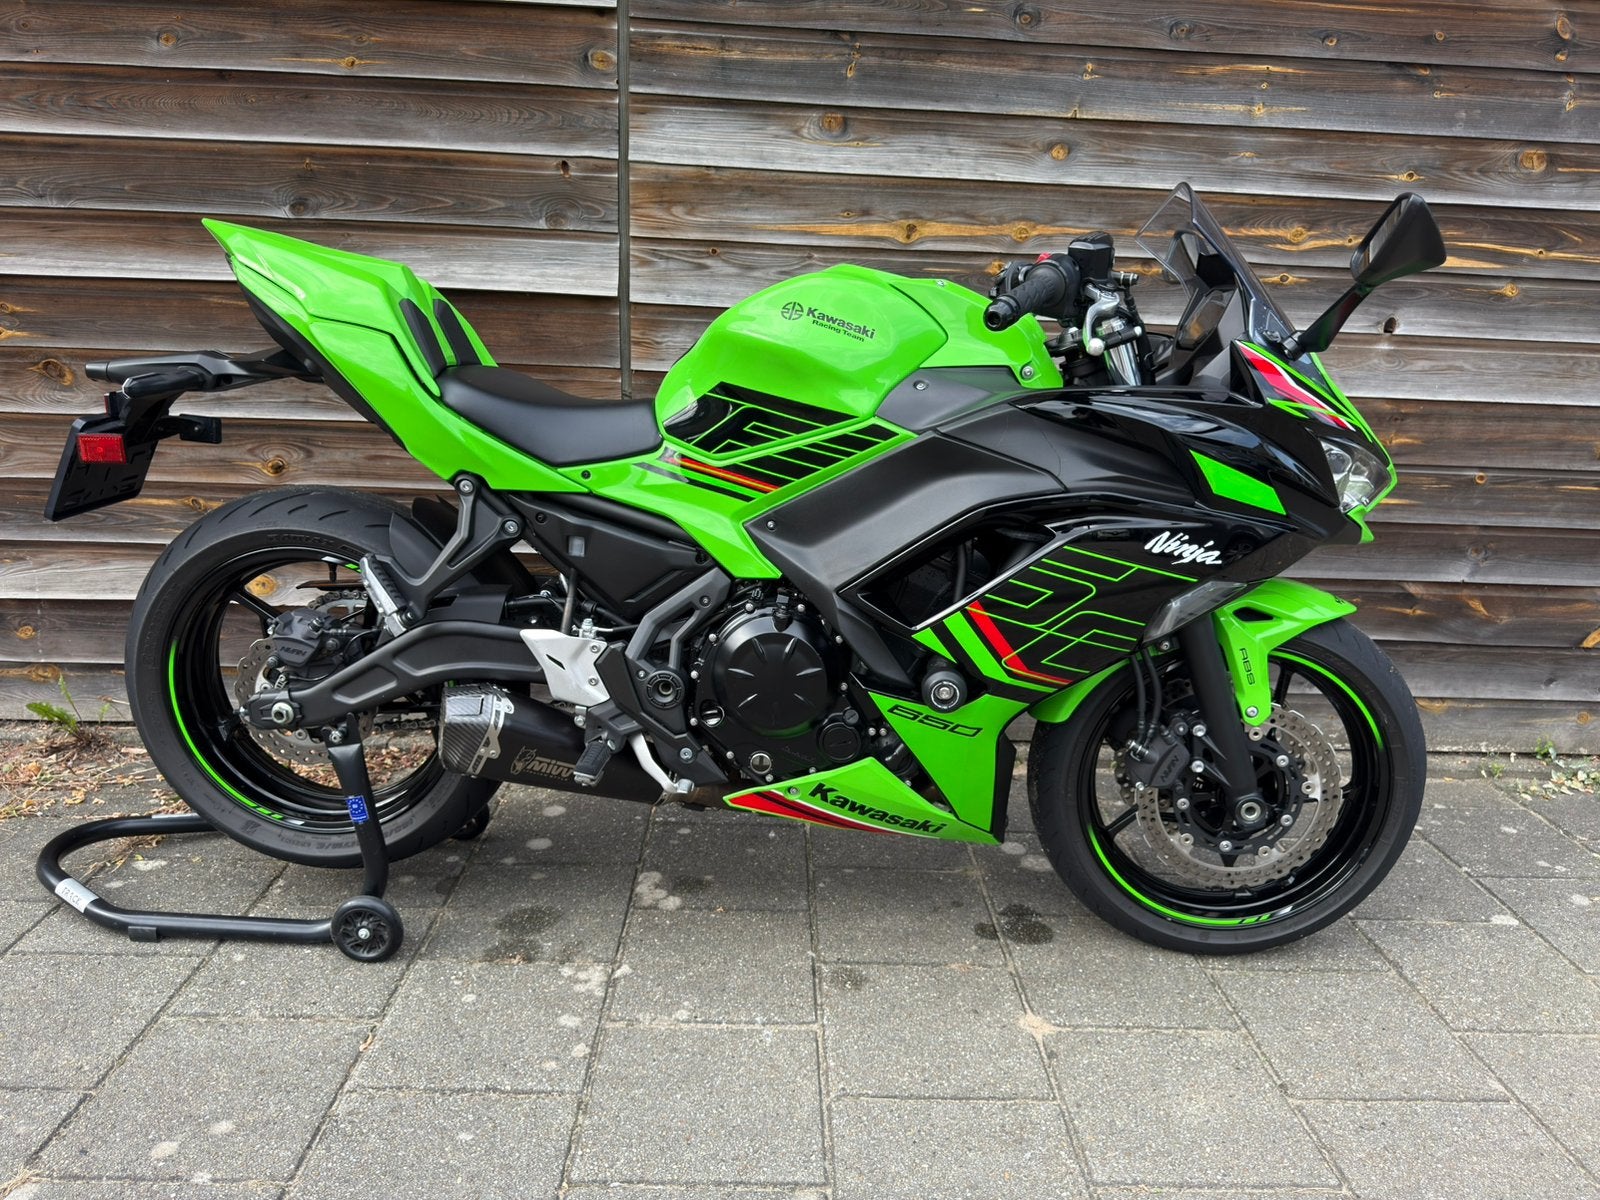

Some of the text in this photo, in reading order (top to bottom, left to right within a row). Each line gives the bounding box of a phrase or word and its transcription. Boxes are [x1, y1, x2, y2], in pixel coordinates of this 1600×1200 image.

[806, 307, 875, 339] Kawasaki
[812, 319, 865, 342] Racing Team
[1144, 531, 1222, 565] Ninja
[1239, 647, 1256, 685] ABS
[887, 704, 983, 737] 650
[808, 782, 947, 834] Kawasaki
